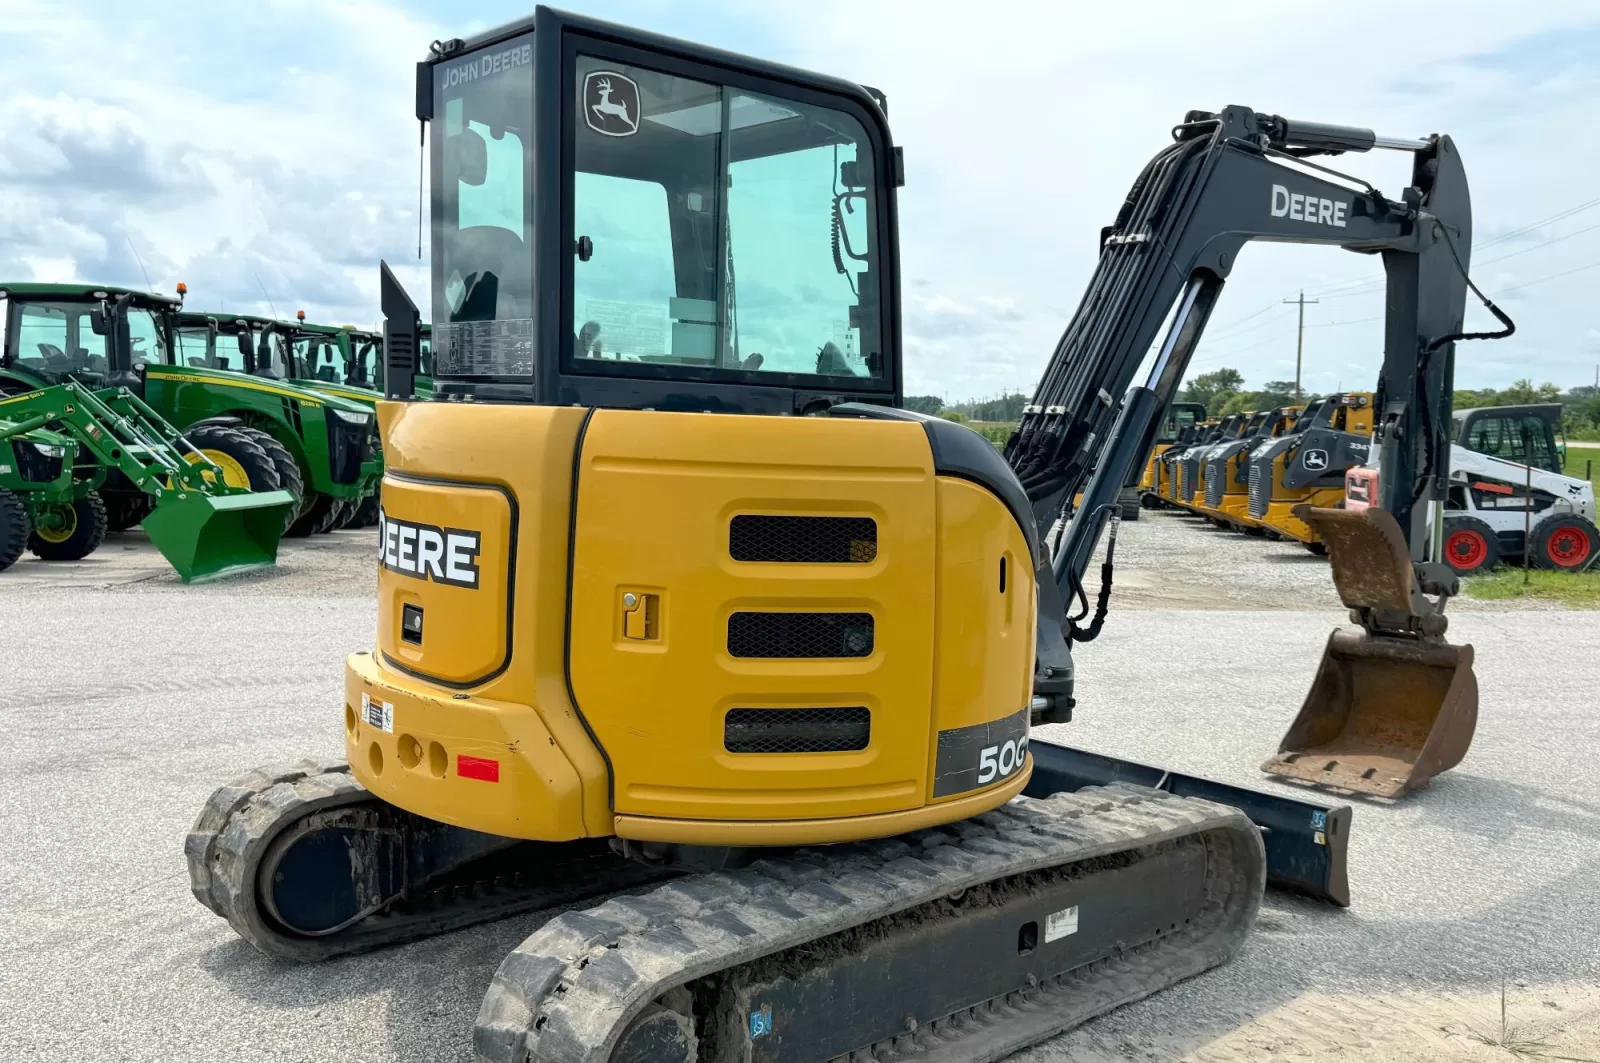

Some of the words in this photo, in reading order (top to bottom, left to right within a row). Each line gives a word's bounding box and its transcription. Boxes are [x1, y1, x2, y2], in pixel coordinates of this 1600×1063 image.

[442, 61, 479, 90] JOHN
[482, 43, 531, 77] DEERE
[1271, 184, 1347, 227] DEERE
